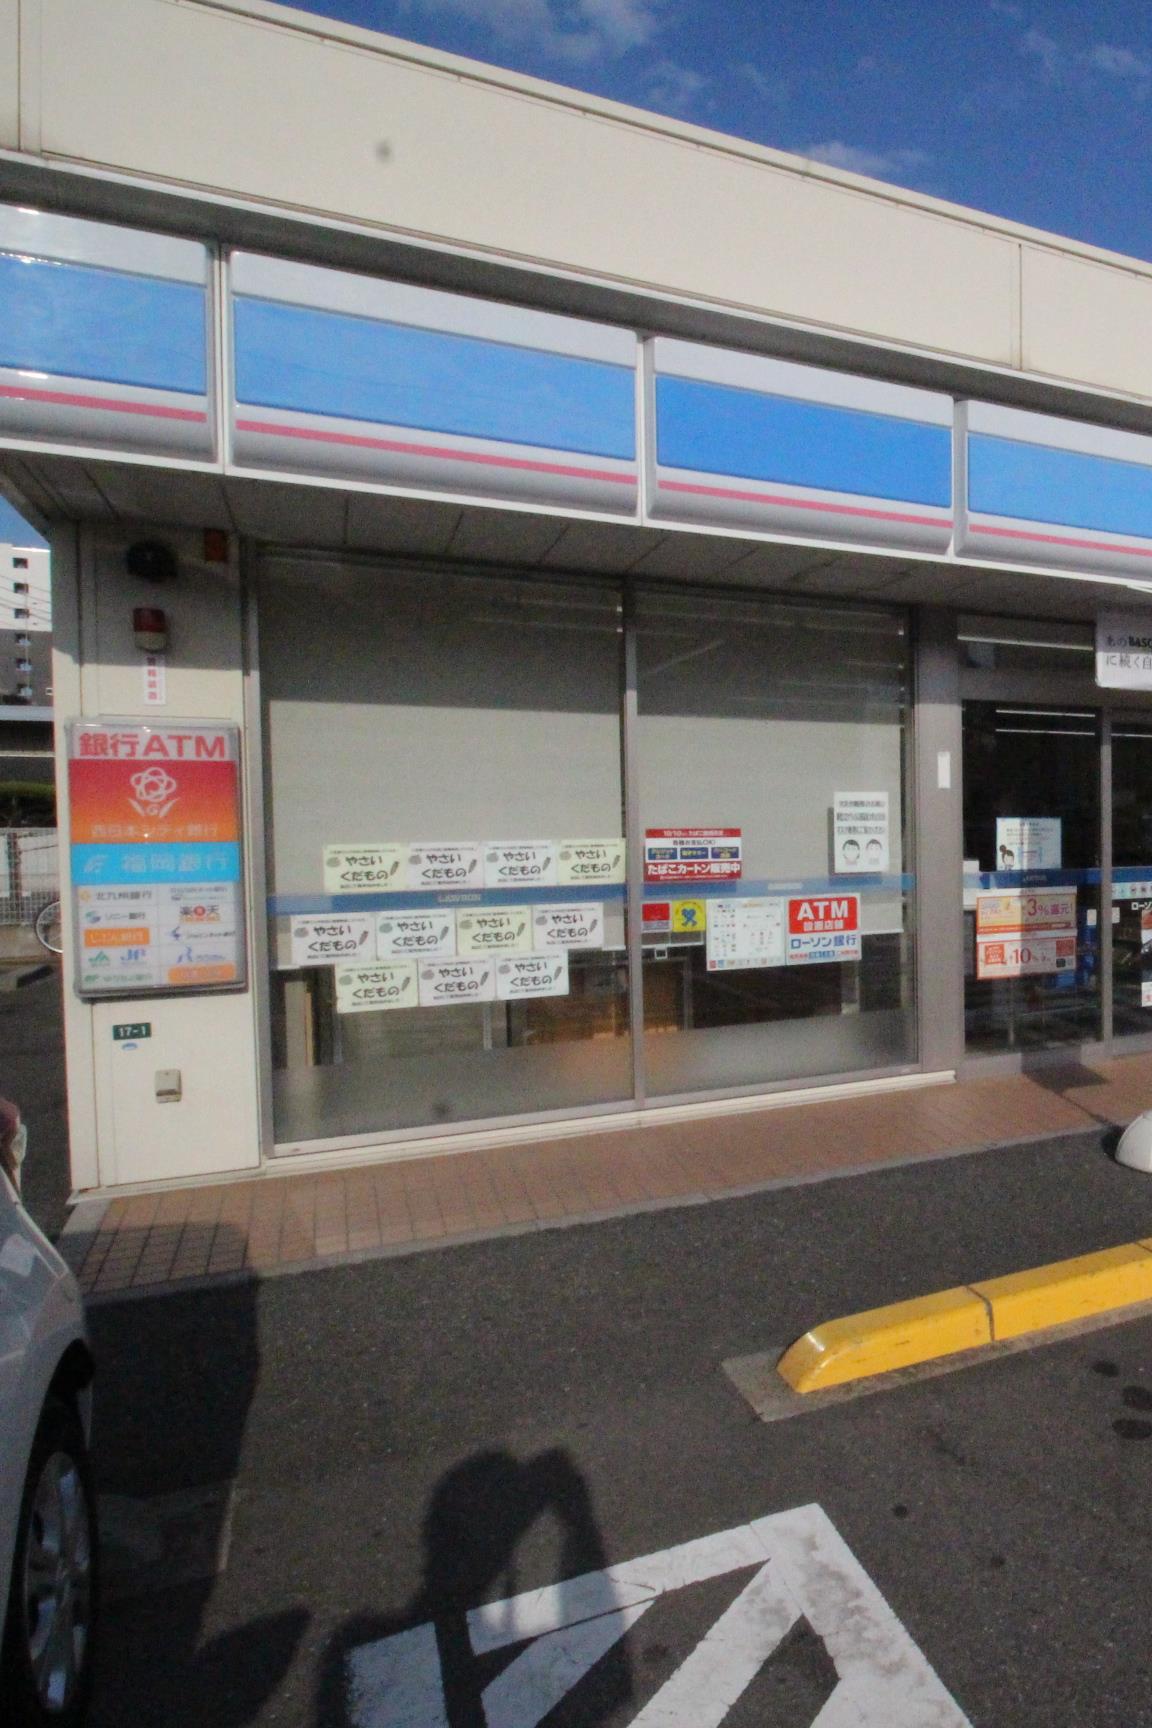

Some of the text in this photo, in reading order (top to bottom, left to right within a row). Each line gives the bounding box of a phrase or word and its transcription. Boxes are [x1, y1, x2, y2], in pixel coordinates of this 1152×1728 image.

[79, 732, 226, 758] 銀行ATM
[426, 854, 461, 864] やさい
[503, 851, 536, 861] やさい
[575, 849, 606, 860] やさい
[346, 856, 383, 866] やさい
[422, 868, 467, 878] くだもの
[499, 865, 540, 876] くだもの
[571, 863, 611, 873] くだもの
[340, 870, 388, 881] くだもの
[797, 900, 849, 920] ATM
[477, 918, 510, 928] やさい
[552, 914, 583, 924] やさい
[313, 926, 351, 937] やさい
[397, 921, 433, 932] やさい
[472, 932, 515, 943] くだもの
[547, 928, 588, 938] くだもの
[308, 940, 357, 952] くだもの
[392, 935, 438, 947] くだもの
[791, 934, 857, 949] ローソン銀行
[439, 967, 474, 978] やさい
[514, 962, 547, 972] やさい
[357, 973, 394, 983] やさい
[509, 975, 552, 987] くだもの
[353, 986, 400, 999] くだもの
[434, 981, 479, 993] くだもの
[118, 1026, 147, 1036] 17-1
